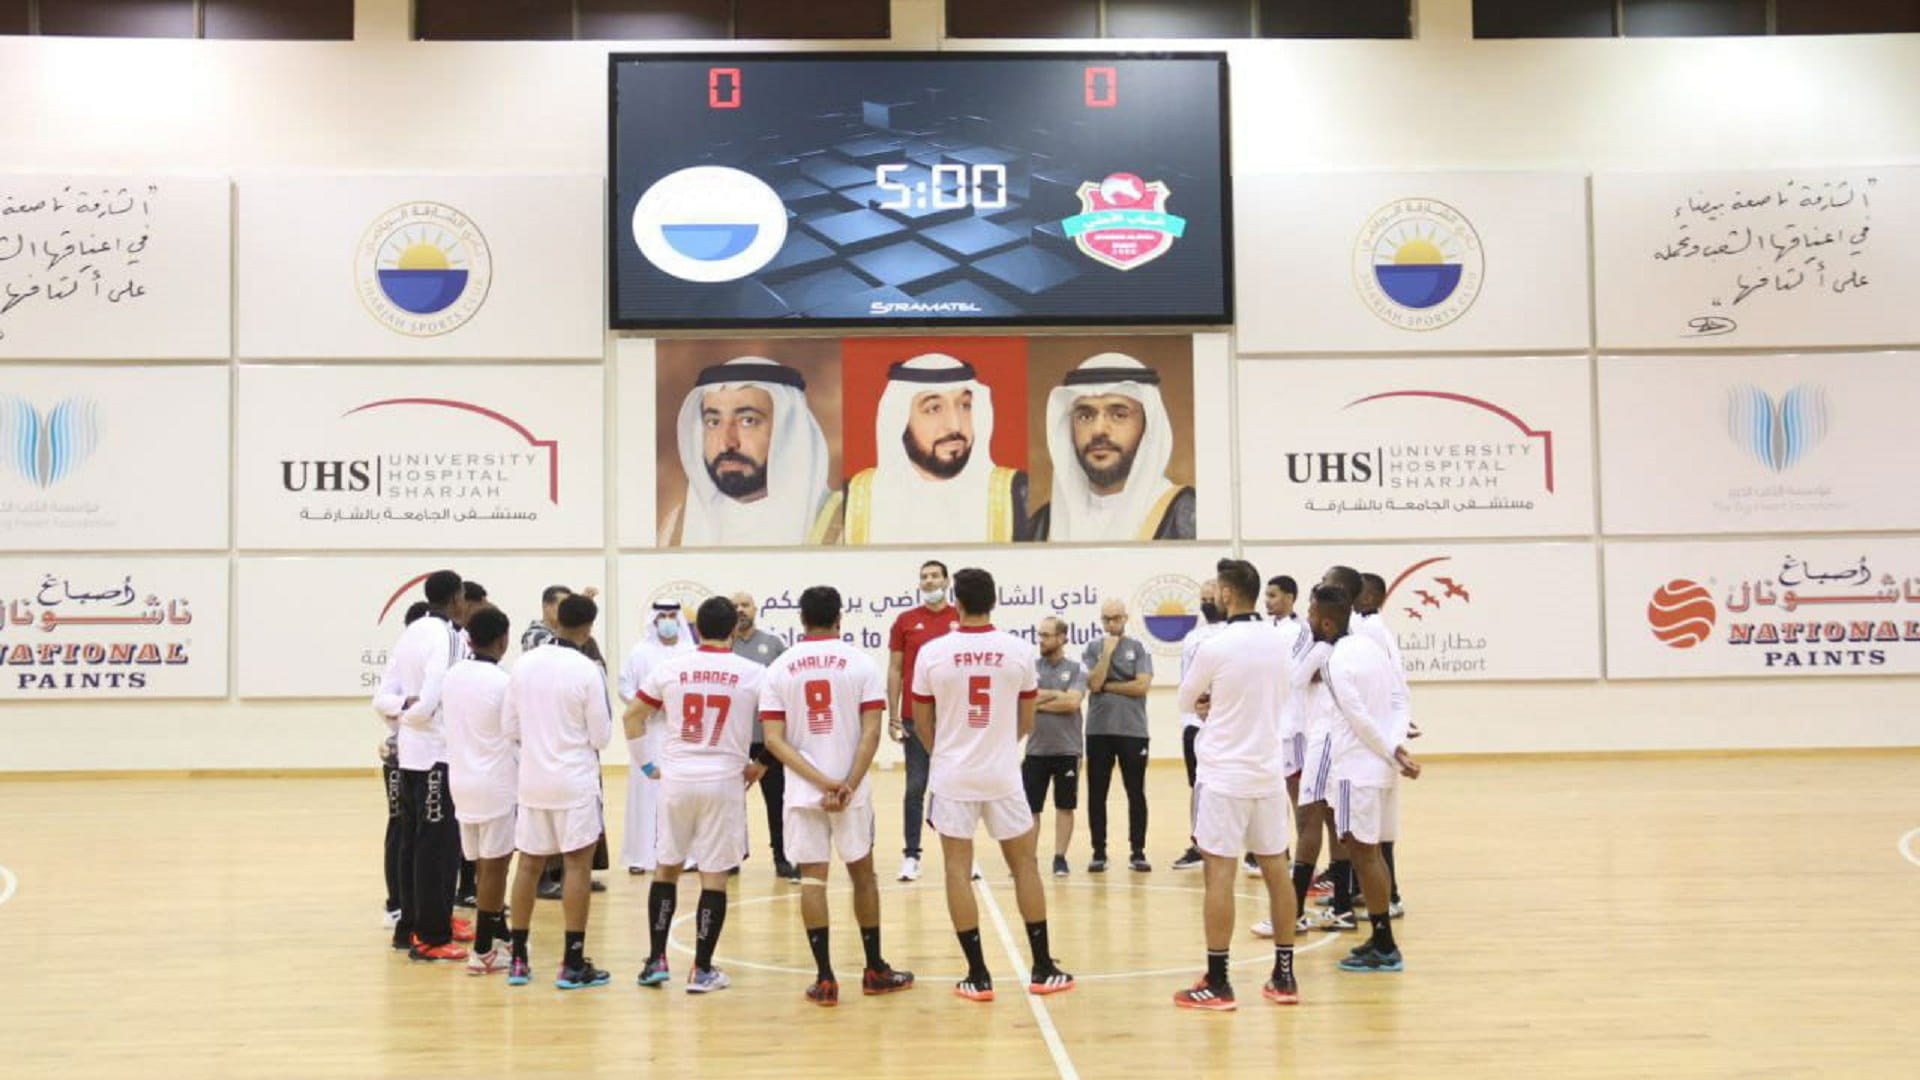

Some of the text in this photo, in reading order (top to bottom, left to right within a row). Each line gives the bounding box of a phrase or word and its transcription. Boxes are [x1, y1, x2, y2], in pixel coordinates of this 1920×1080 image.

[709, 68, 741, 108] 0
[1085, 68, 1117, 106] 0
[876, 164, 1006, 208] 5:00
[869, 302, 982, 314] STRAMATEL
[388, 454, 537, 466] UNIVERSITY
[1390, 444, 1532, 457] UNIVERSITY
[280, 460, 371, 492] UHS
[388, 469, 509, 482] HOSPITAL
[1285, 452, 1372, 483] UHS
[1390, 460, 1506, 472] HOSPITAL
[388, 485, 501, 498] SHARJAH
[1390, 476, 1498, 489] SHARJAH
[300, 505, 382, 524] بالشارقة
[384, 507, 451, 521] الجامعة
[1305, 497, 1383, 515] بالشارقة
[1385, 498, 1450, 511] الجامعة
[1778, 555, 1872, 587] أصباغ
[37, 574, 136, 607] أصباغ
[998, 585, 1043, 606] الشا
[1051, 585, 1098, 615] نادي
[862, 627, 882, 648] to
[1728, 620, 1920, 644] NATIONAL
[1397, 632, 1487, 654] مطار الشا
[787, 655, 847, 675] KHALIFA
[954, 652, 1004, 667] FAYEZ
[1430, 657, 1486, 673] Airport
[1765, 650, 1886, 667] PAINTS
[18, 672, 147, 689] PAINTS
[805, 680, 832, 734] 8
[968, 676, 990, 728] 5
[680, 692, 731, 746] 87
